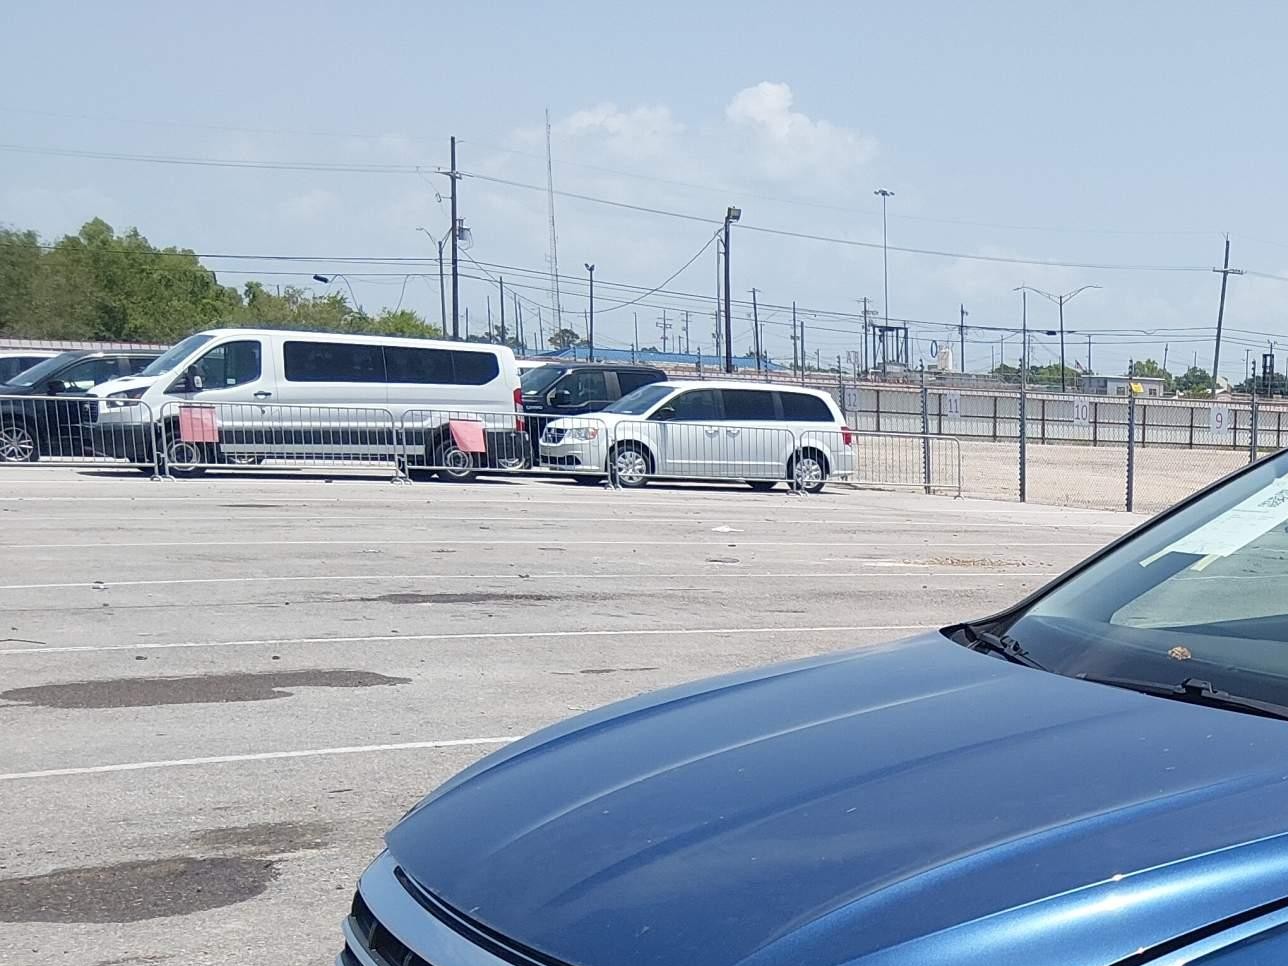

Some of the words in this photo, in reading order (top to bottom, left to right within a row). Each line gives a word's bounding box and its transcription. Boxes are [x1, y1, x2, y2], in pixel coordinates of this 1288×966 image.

[948, 398, 959, 413] 11
[1075, 404, 1088, 421] 10
[1215, 412, 1223, 430] 9
